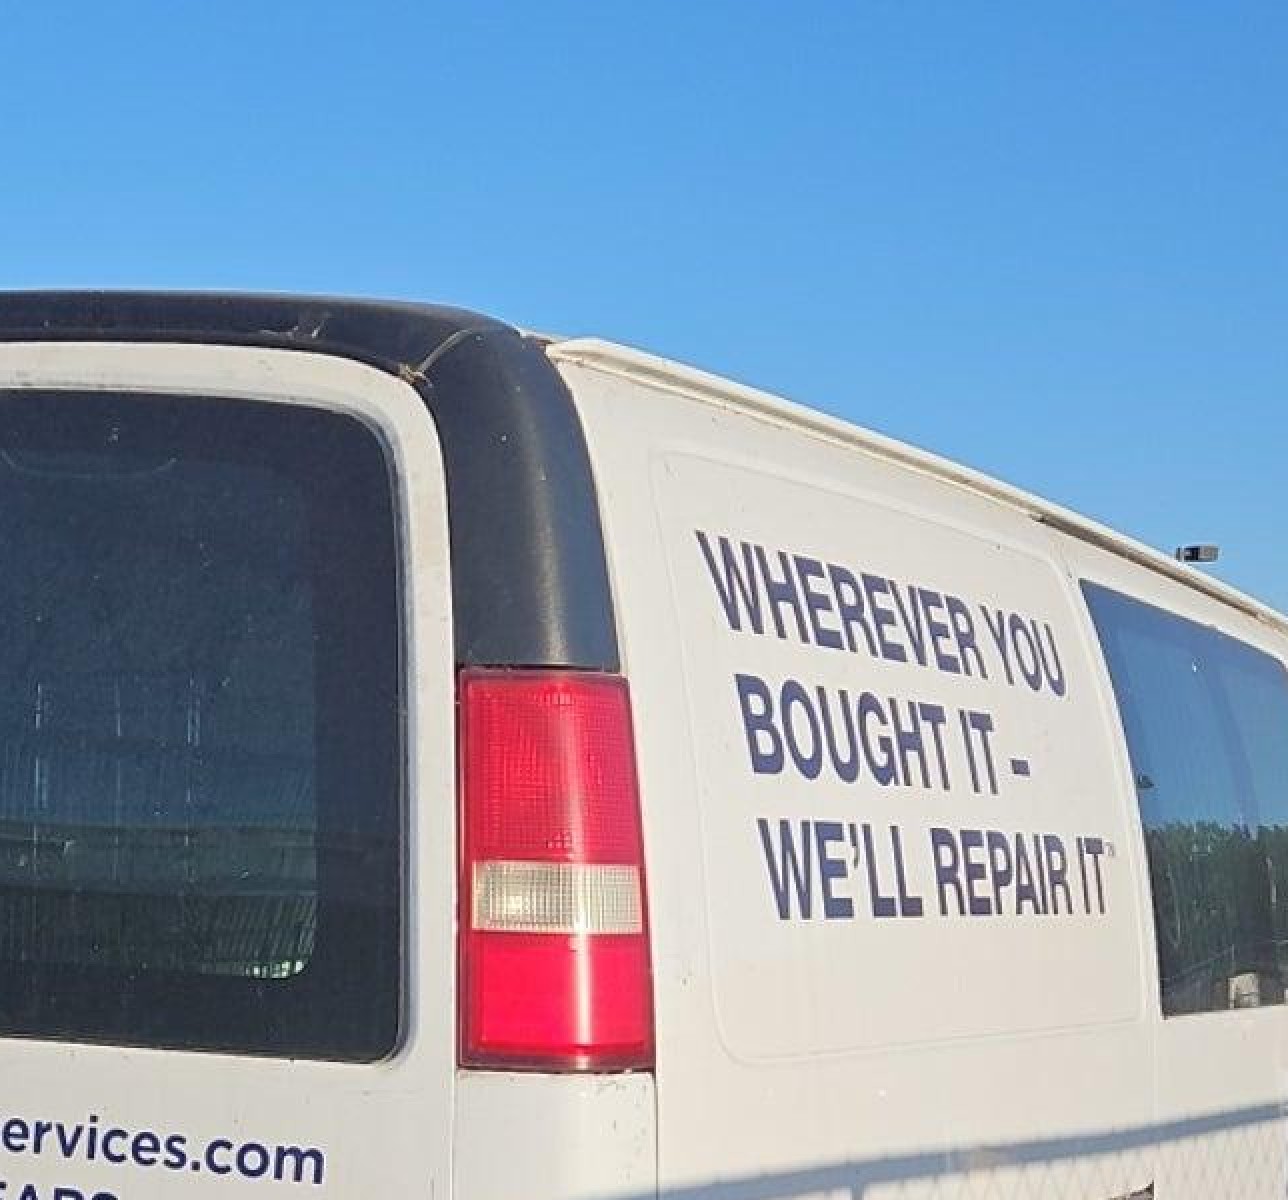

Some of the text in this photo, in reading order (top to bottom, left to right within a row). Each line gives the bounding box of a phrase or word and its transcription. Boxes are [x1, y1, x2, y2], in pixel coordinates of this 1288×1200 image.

[695, 529, 1066, 697] WHEREVER YOU
[734, 673, 951, 791] BOUGHT
[958, 709, 998, 795] IT
[757, 817, 1106, 920] WE'LL REPAIR IT
